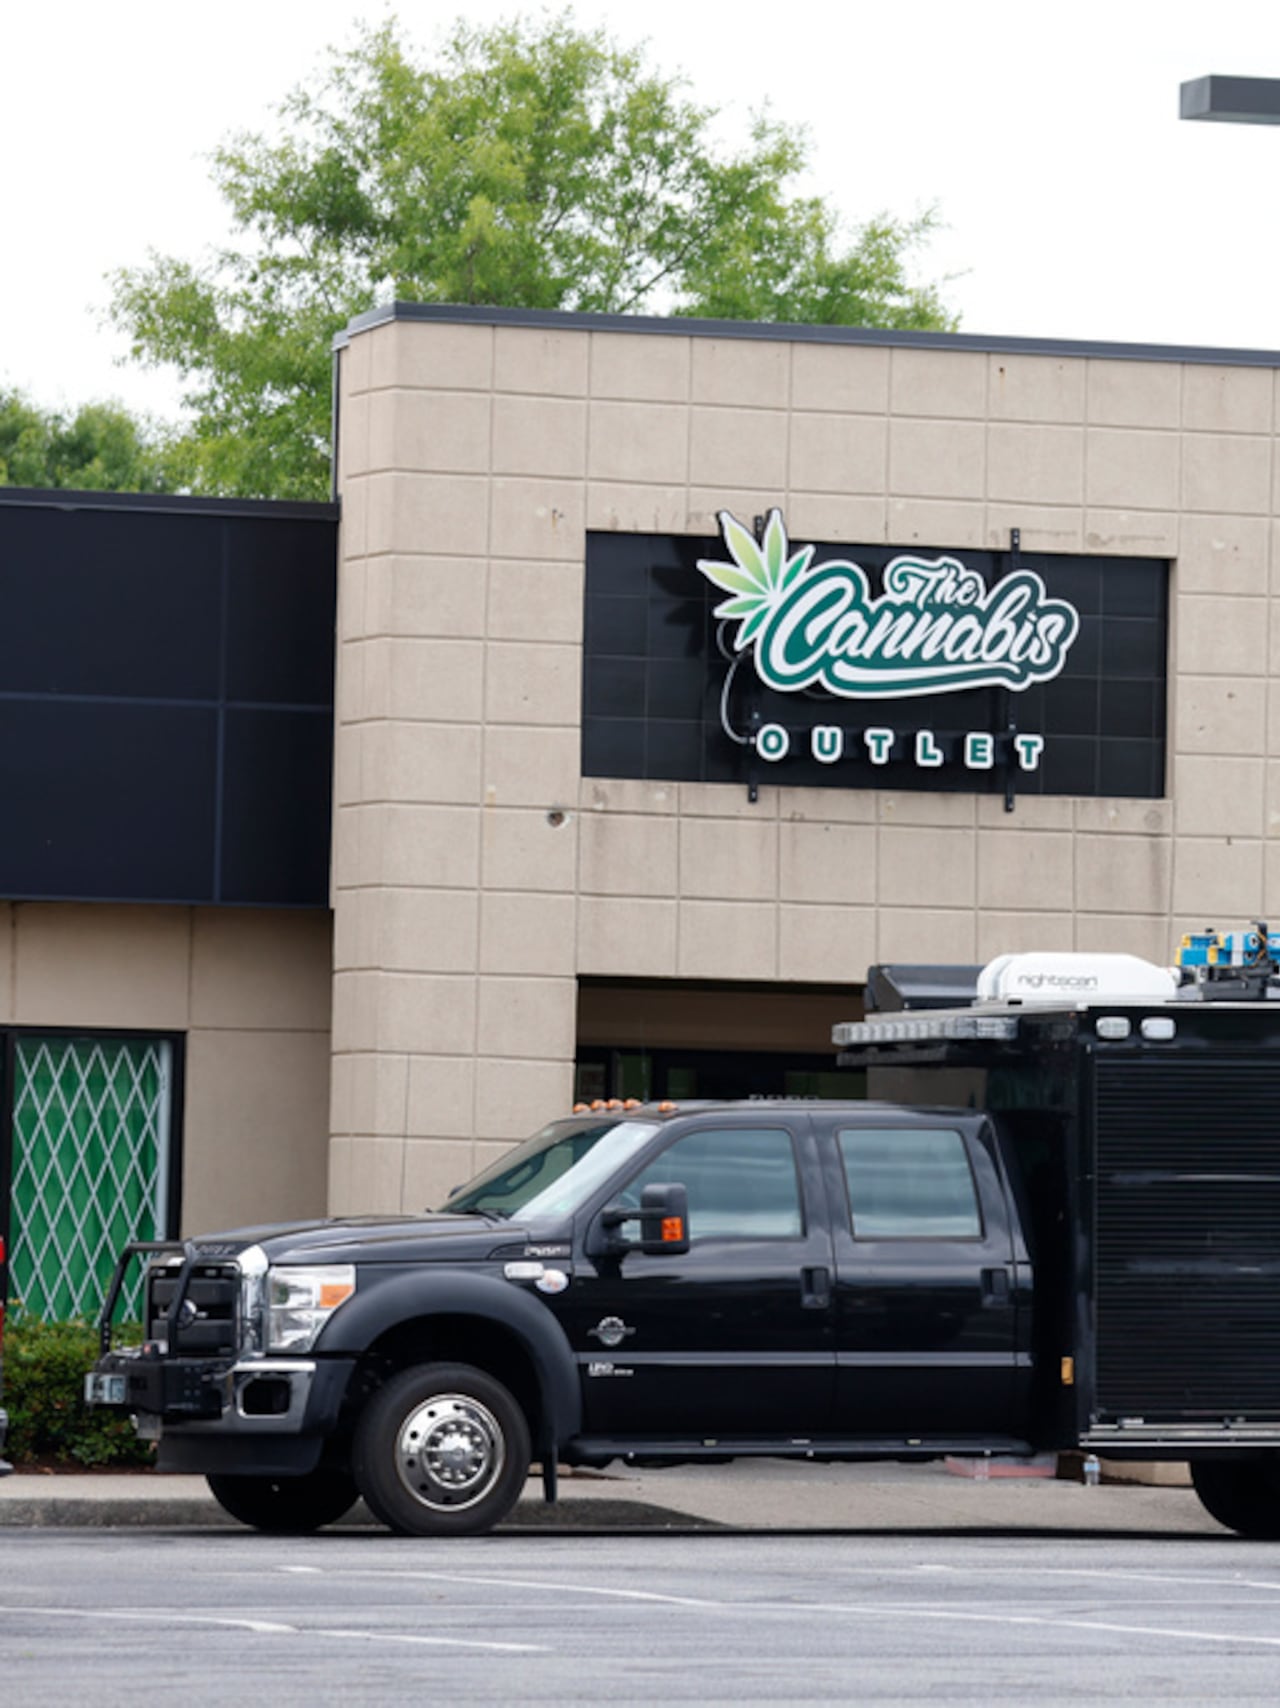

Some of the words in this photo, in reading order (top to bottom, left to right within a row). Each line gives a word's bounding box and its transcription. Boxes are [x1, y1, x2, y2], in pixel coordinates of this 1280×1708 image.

[886, 558, 983, 610] The
[764, 570, 1070, 680] Cannabis
[757, 725, 1043, 770] OUTLET
[1017, 973, 1098, 988] nightscan
